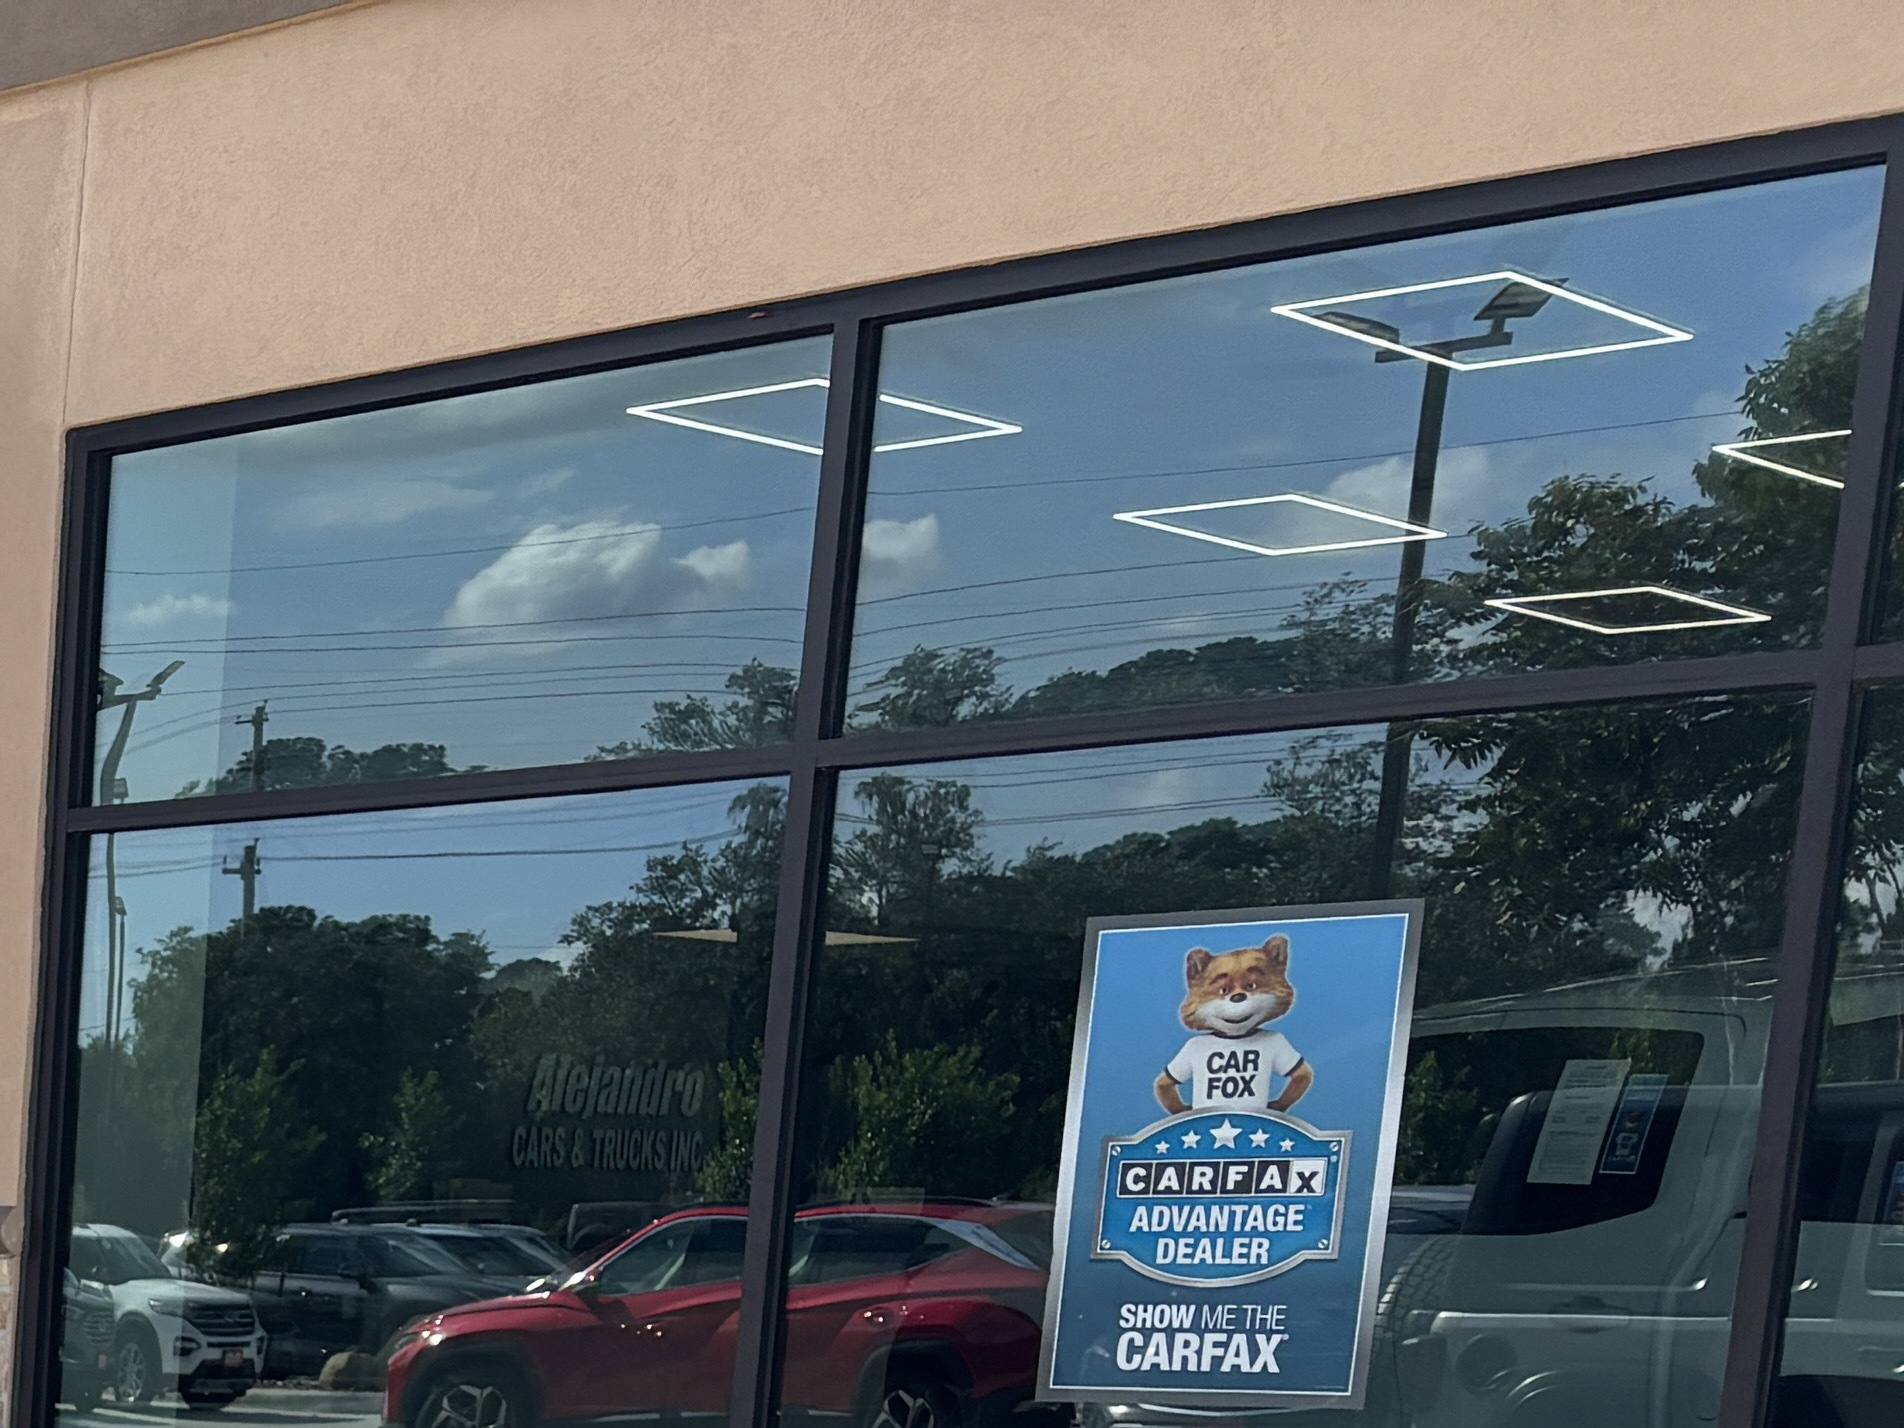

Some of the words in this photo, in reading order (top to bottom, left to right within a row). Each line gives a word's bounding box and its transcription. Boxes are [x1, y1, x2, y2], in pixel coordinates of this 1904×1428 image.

[1205, 1049, 1261, 1075] CAR
[527, 1052, 705, 1119] Alejandro
[1206, 1073, 1257, 1100] FOX
[512, 1125, 566, 1169] CARS
[570, 1126, 585, 1169] &
[592, 1127, 668, 1171] TRUCKS
[1122, 1161, 1325, 1197] CARFAX
[1128, 1203, 1305, 1234] ADVANTAGE
[1155, 1237, 1270, 1266] DEALER
[1118, 1303, 1196, 1331] SHOW
[1200, 1305, 1242, 1330] ME
[1242, 1304, 1288, 1330] THE
[1116, 1333, 1285, 1374] CARFAX
